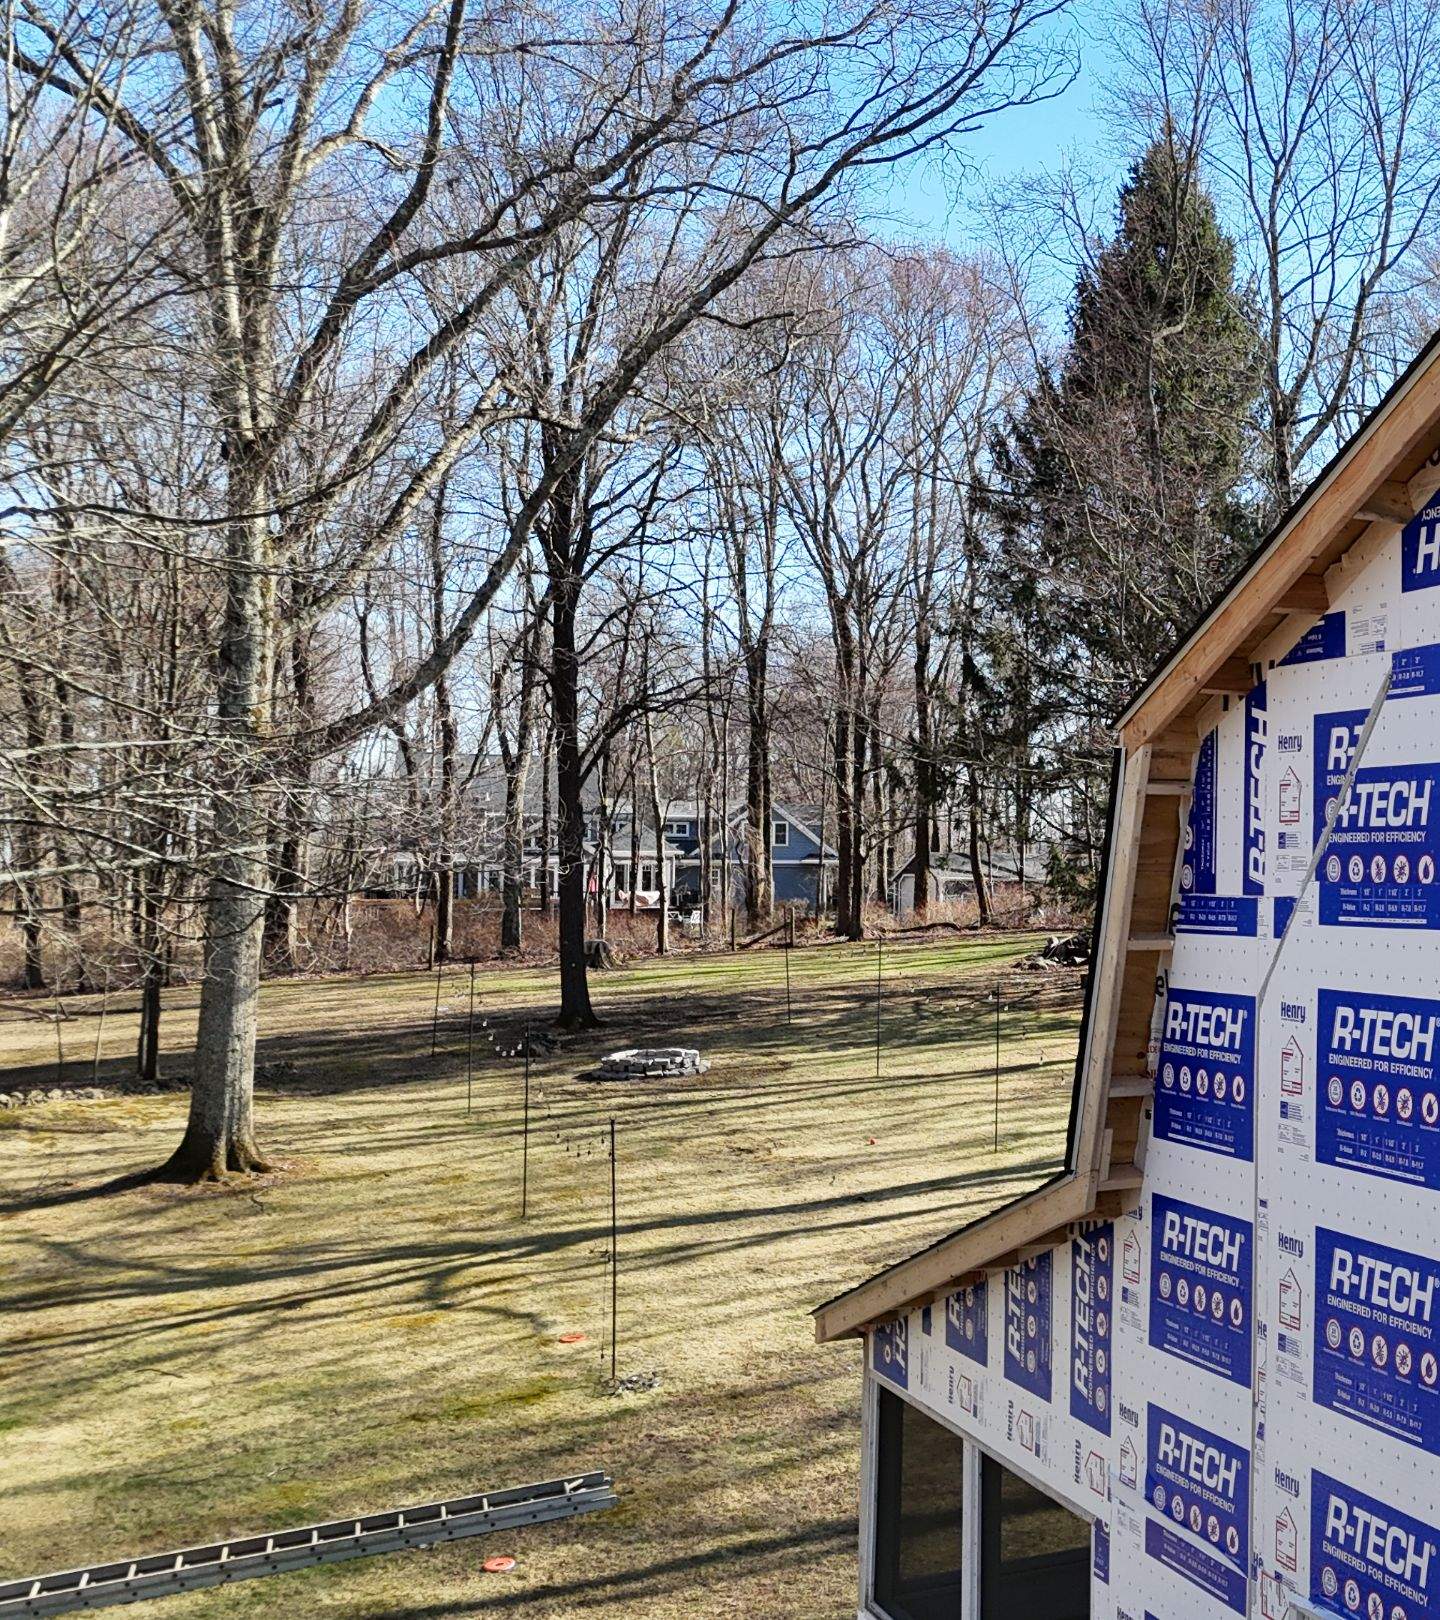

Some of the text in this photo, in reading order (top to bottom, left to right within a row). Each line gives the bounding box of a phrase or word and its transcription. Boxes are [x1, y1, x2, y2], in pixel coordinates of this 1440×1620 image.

[1277, 734, 1303, 752] Henry
[1328, 831, 1427, 843] ENGINEERED FOR EFFICIENCY
[1165, 1001, 1244, 1050] R-TECH
[1280, 1001, 1306, 1023] Henry
[1331, 1006, 1436, 1063] R-TECH
[1163, 1042, 1242, 1065] ENGINEERED FOR EFFICIENCY
[1328, 1053, 1434, 1080] ENGINEERED FOR EFFICIENCY
[1162, 1210, 1242, 1273] R-TECH
[1278, 1231, 1304, 1259] Henry
[1160, 1250, 1240, 1287] ENGINEERED FOR EFFICIENCY
[1329, 1247, 1435, 1322] R-TECH
[1074, 1236, 1092, 1401] R-TECH
[1327, 1295, 1433, 1340] ENGINEERED FOR EFFICIENCY
[1006, 1399, 1014, 1441] Henry
[1118, 1402, 1139, 1428] Henry
[1074, 1438, 1082, 1484] Henry
[1158, 1422, 1237, 1499] R-TECH
[1275, 1467, 1300, 1499] Henry
[1155, 1462, 1235, 1514] ENGINEERED FOR EFFICIENCY
[1324, 1493, 1431, 1589] R-TECH
[1322, 1540, 1429, 1608] ENGINEERED FOR EFFICIENCY
